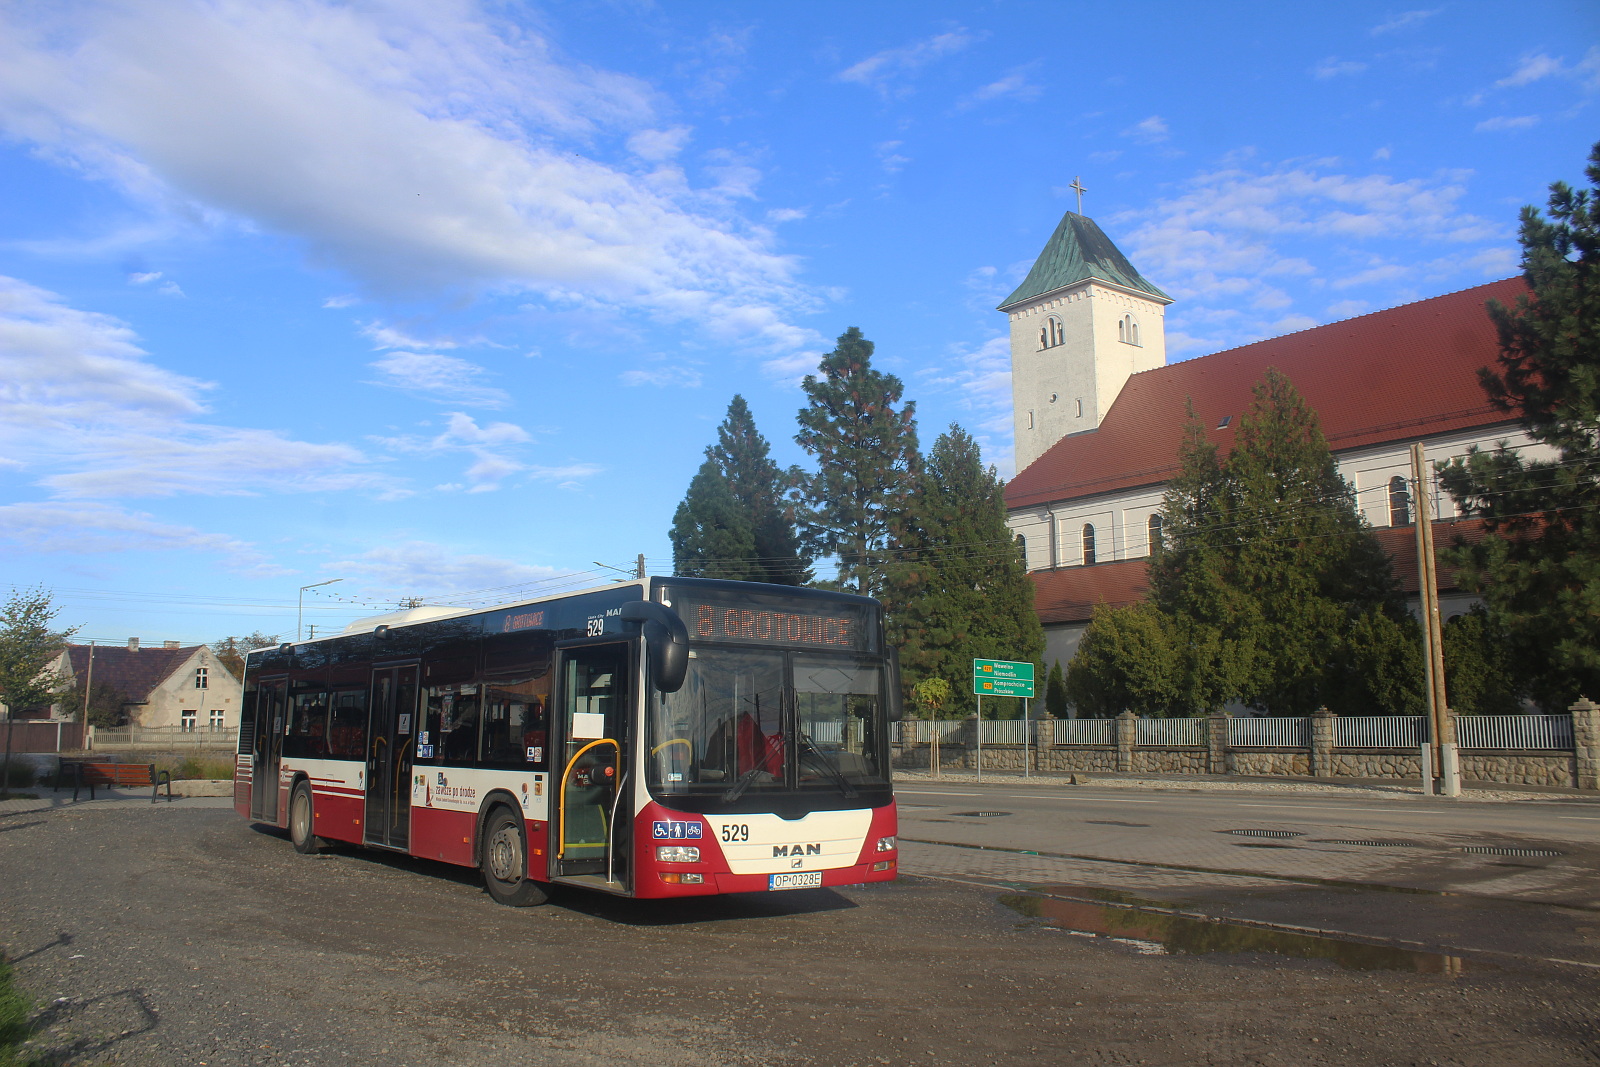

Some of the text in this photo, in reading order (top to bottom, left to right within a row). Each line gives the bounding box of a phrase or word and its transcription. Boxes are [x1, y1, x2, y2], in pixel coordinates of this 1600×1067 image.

[587, 618, 604, 637] 529
[697, 604, 850, 646] 8 GROTOWICE
[721, 823, 749, 843] 529
[772, 843, 821, 857] MAN
